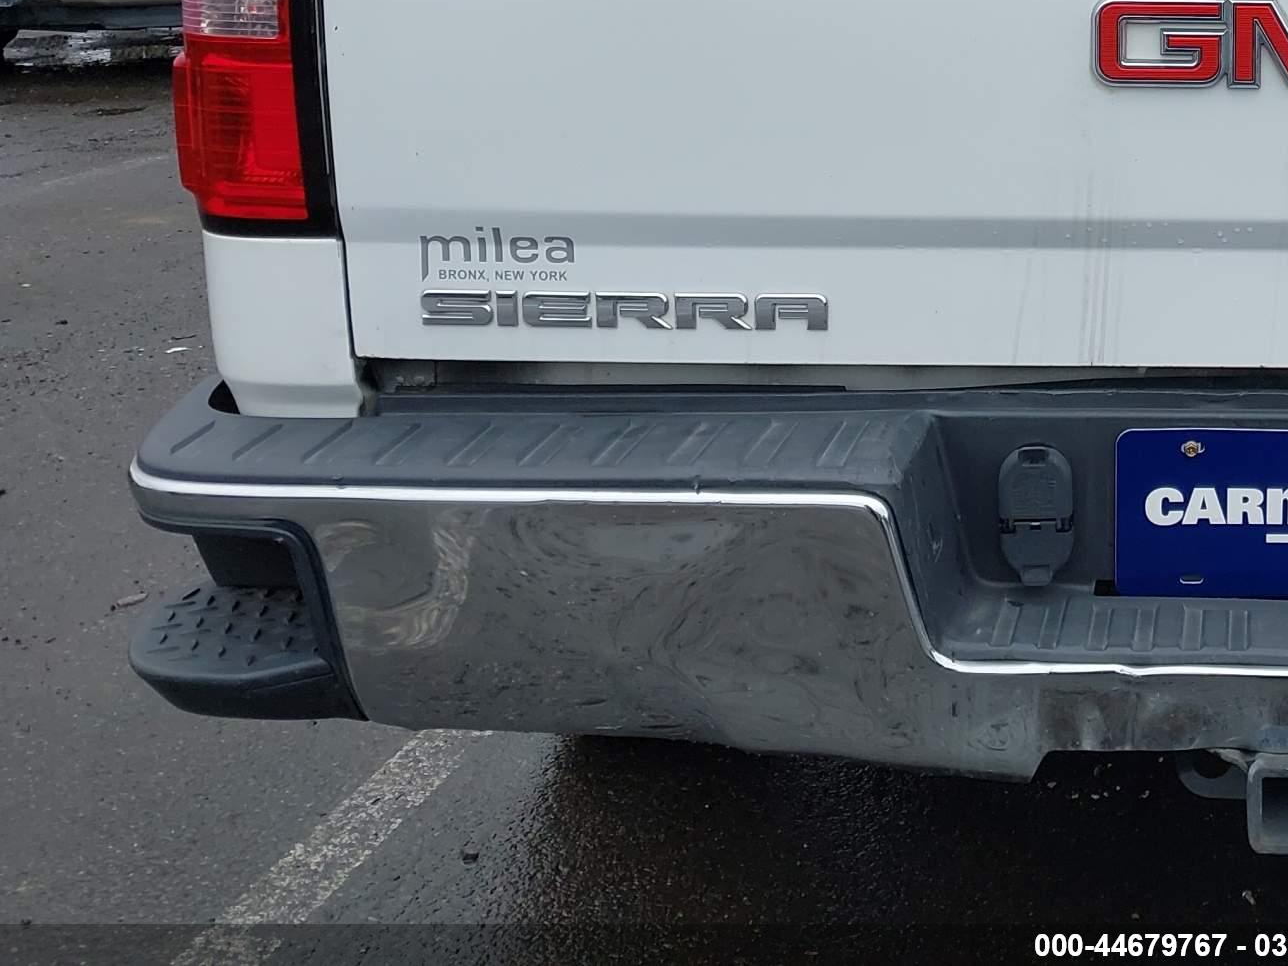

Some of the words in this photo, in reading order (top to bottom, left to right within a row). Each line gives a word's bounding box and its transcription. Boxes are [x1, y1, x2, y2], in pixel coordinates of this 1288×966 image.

[419, 226, 575, 281] milea
[438, 269, 490, 281] BRONX,
[495, 270, 525, 281] NEW
[530, 270, 568, 281] YORK
[420, 289, 829, 330] SIERRA
